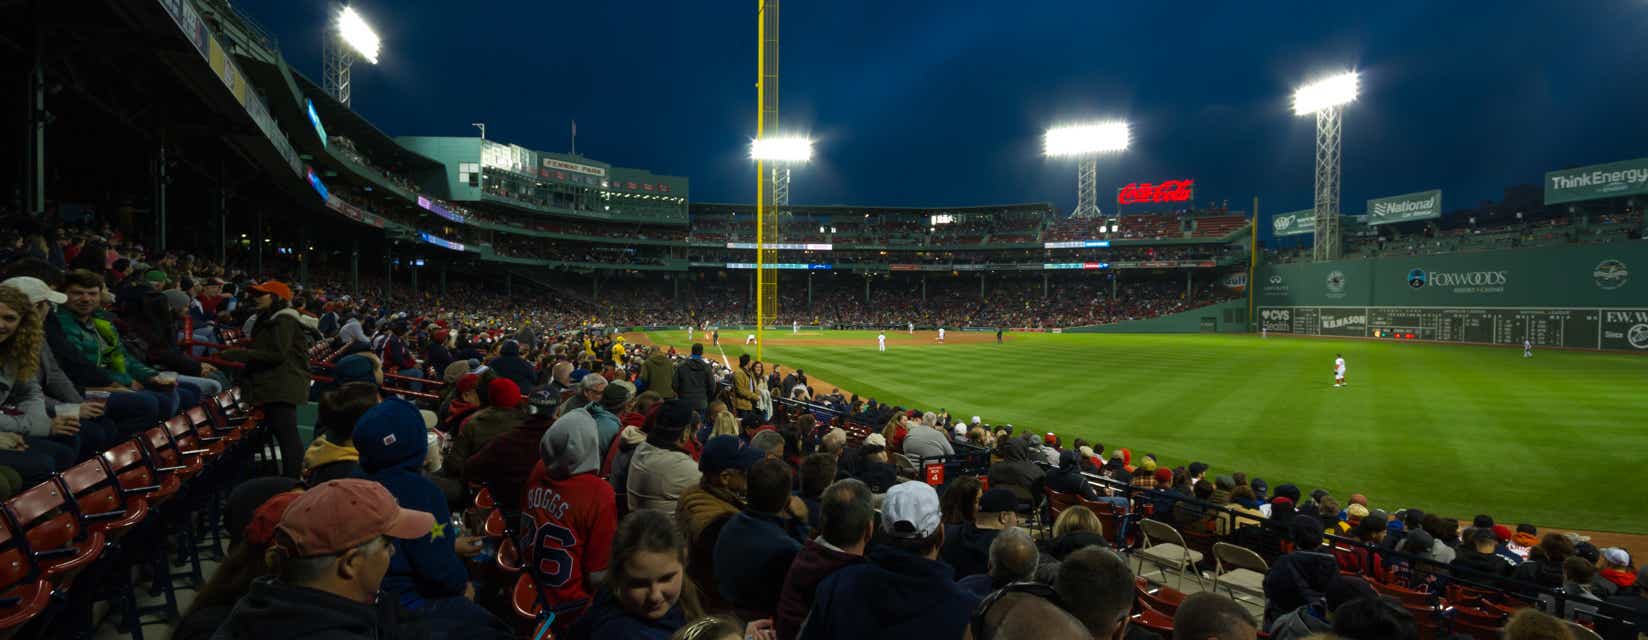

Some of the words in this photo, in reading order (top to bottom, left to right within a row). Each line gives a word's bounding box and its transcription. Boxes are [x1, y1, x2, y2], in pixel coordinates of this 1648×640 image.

[1119, 179, 1194, 204] Coca-Cola
[1386, 196, 1434, 214] National
[1428, 271, 1506, 287] FOXWOODS
[1270, 310, 1290, 321] CVS
[1263, 320, 1290, 331] Health
[527, 487, 569, 520] BOGGS
